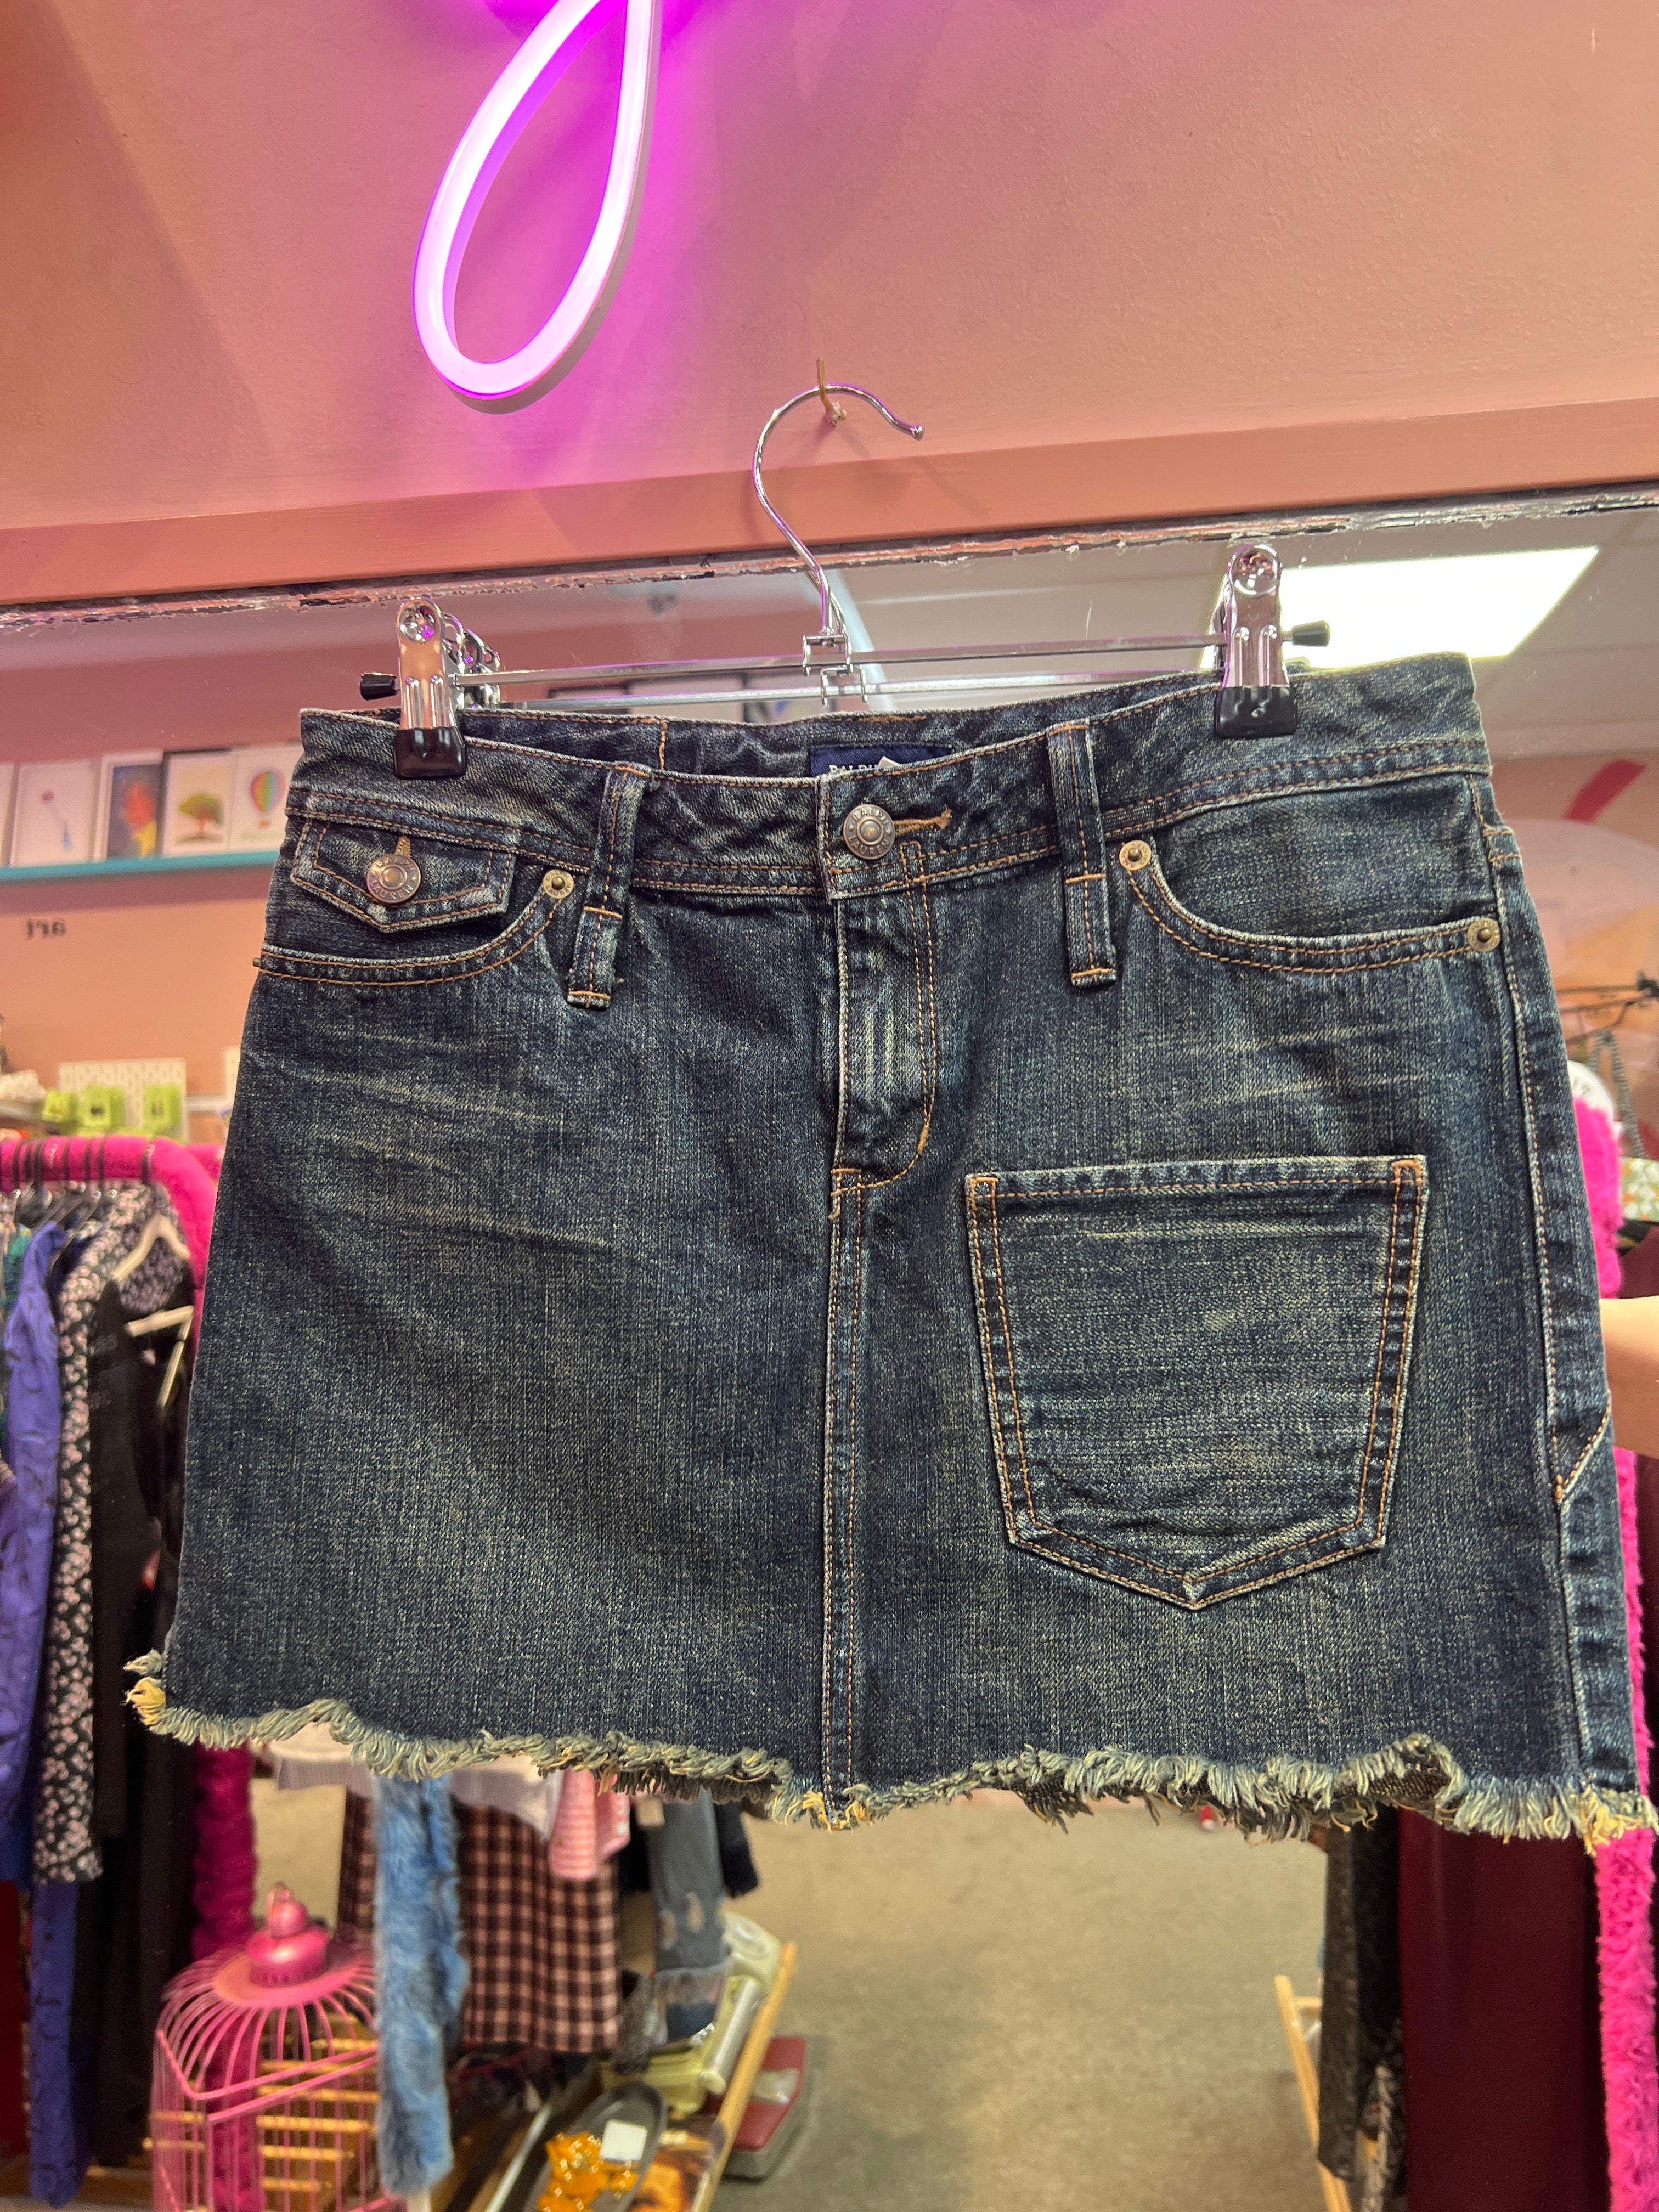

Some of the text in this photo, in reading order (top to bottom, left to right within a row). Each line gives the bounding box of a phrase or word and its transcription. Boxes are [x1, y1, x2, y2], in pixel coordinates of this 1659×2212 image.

[852, 805, 889, 825] RALPH
[848, 834, 889, 855] LAUREN
[370, 879, 413, 900] LAUREN
